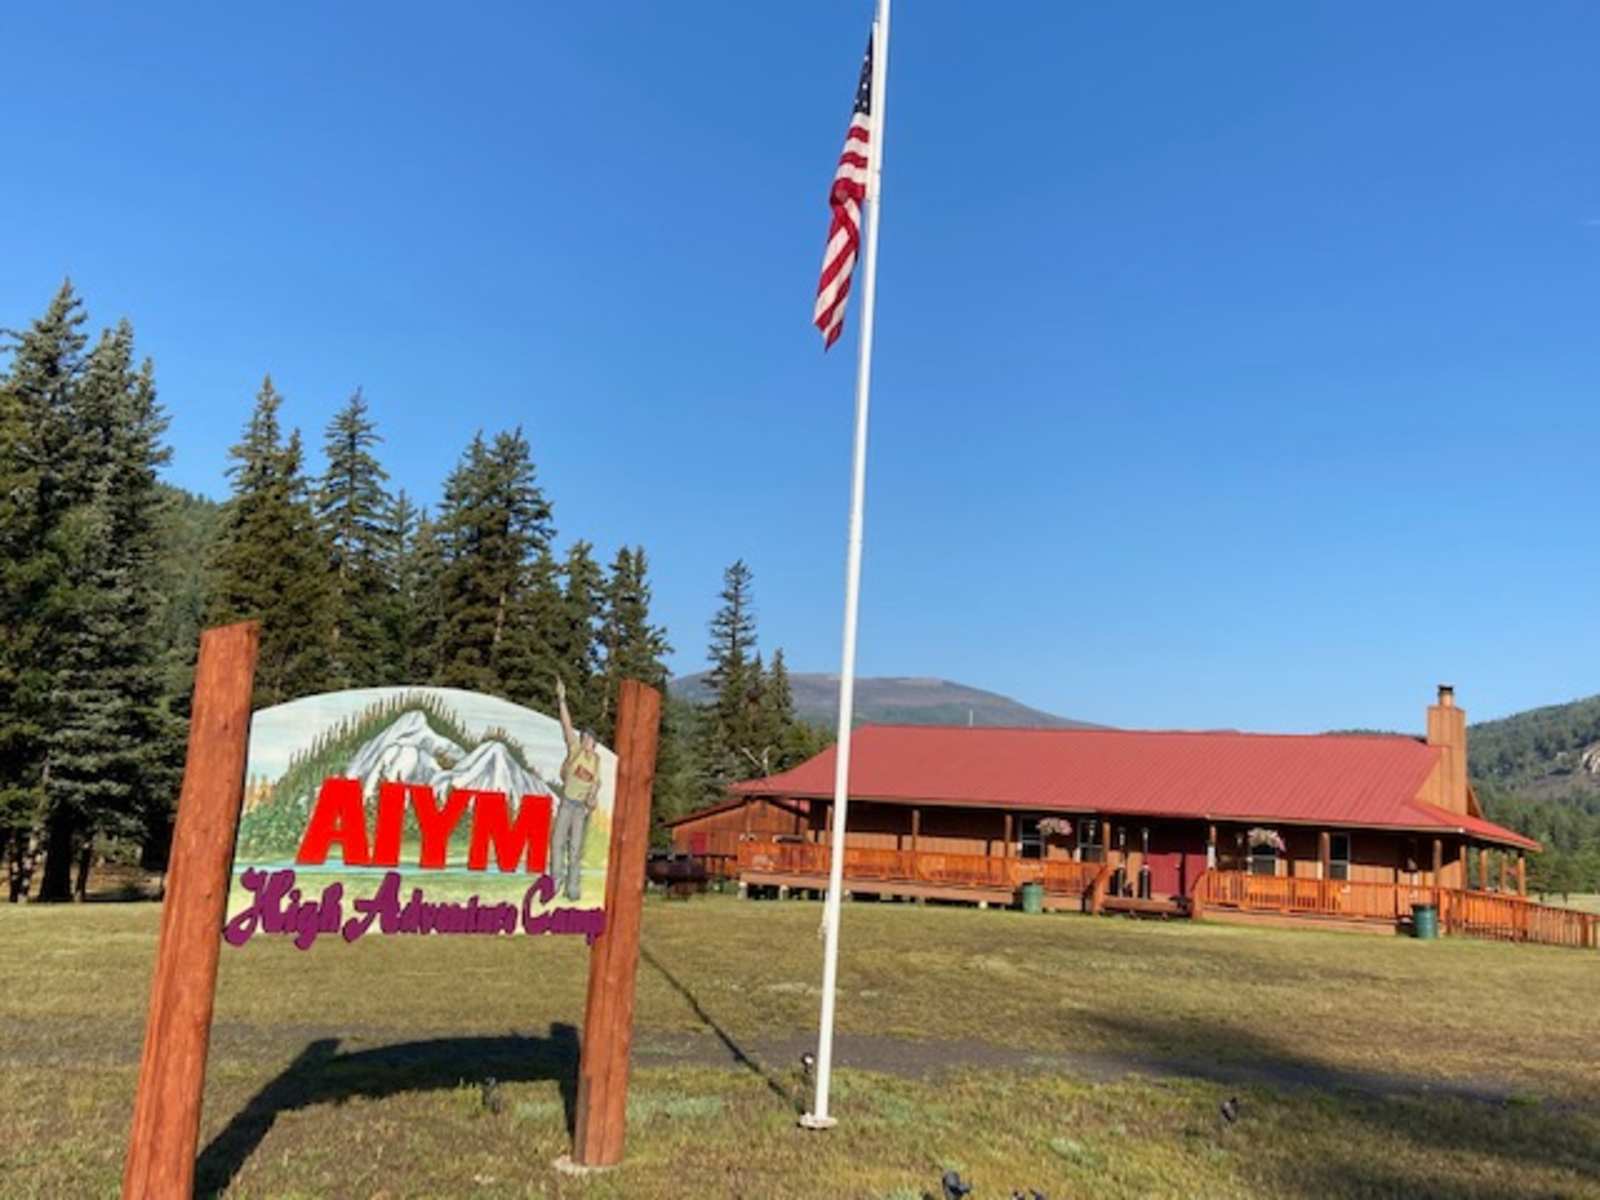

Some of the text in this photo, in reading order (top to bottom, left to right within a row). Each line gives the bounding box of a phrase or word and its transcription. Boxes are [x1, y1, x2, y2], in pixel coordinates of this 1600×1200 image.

[296, 776, 553, 874] AIYM
[223, 867, 343, 950] High
[522, 874, 606, 946] Camp
